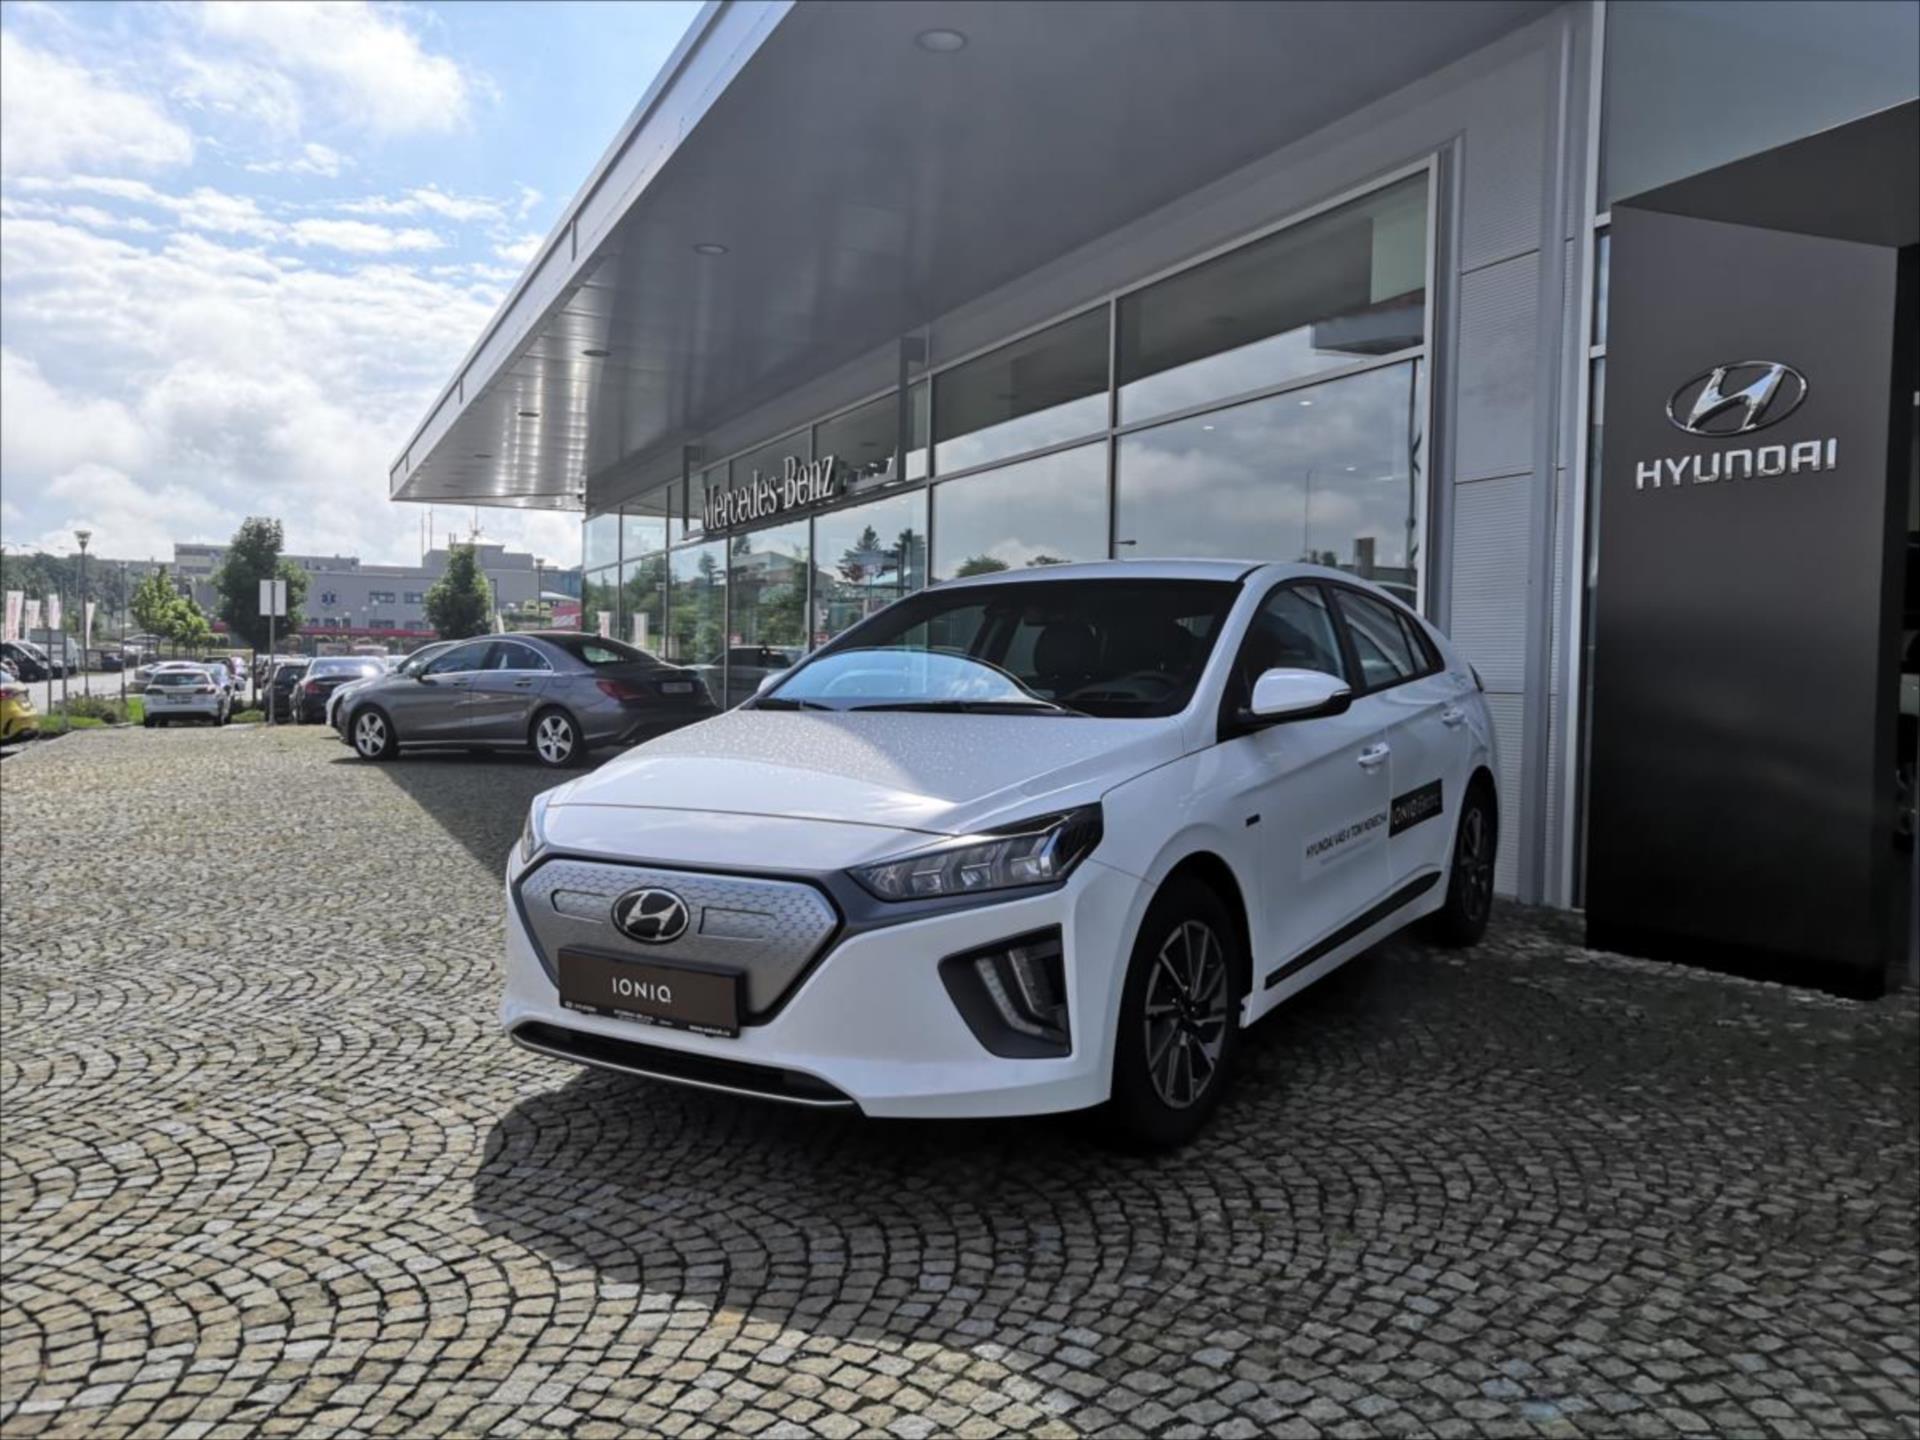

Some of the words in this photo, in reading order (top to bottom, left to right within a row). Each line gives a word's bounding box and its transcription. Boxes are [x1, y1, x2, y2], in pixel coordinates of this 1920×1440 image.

[1635, 438, 1837, 489] HYUNDAI
[702, 454, 835, 530] Mercedes-Benz
[612, 976, 672, 1003] IONIQ
